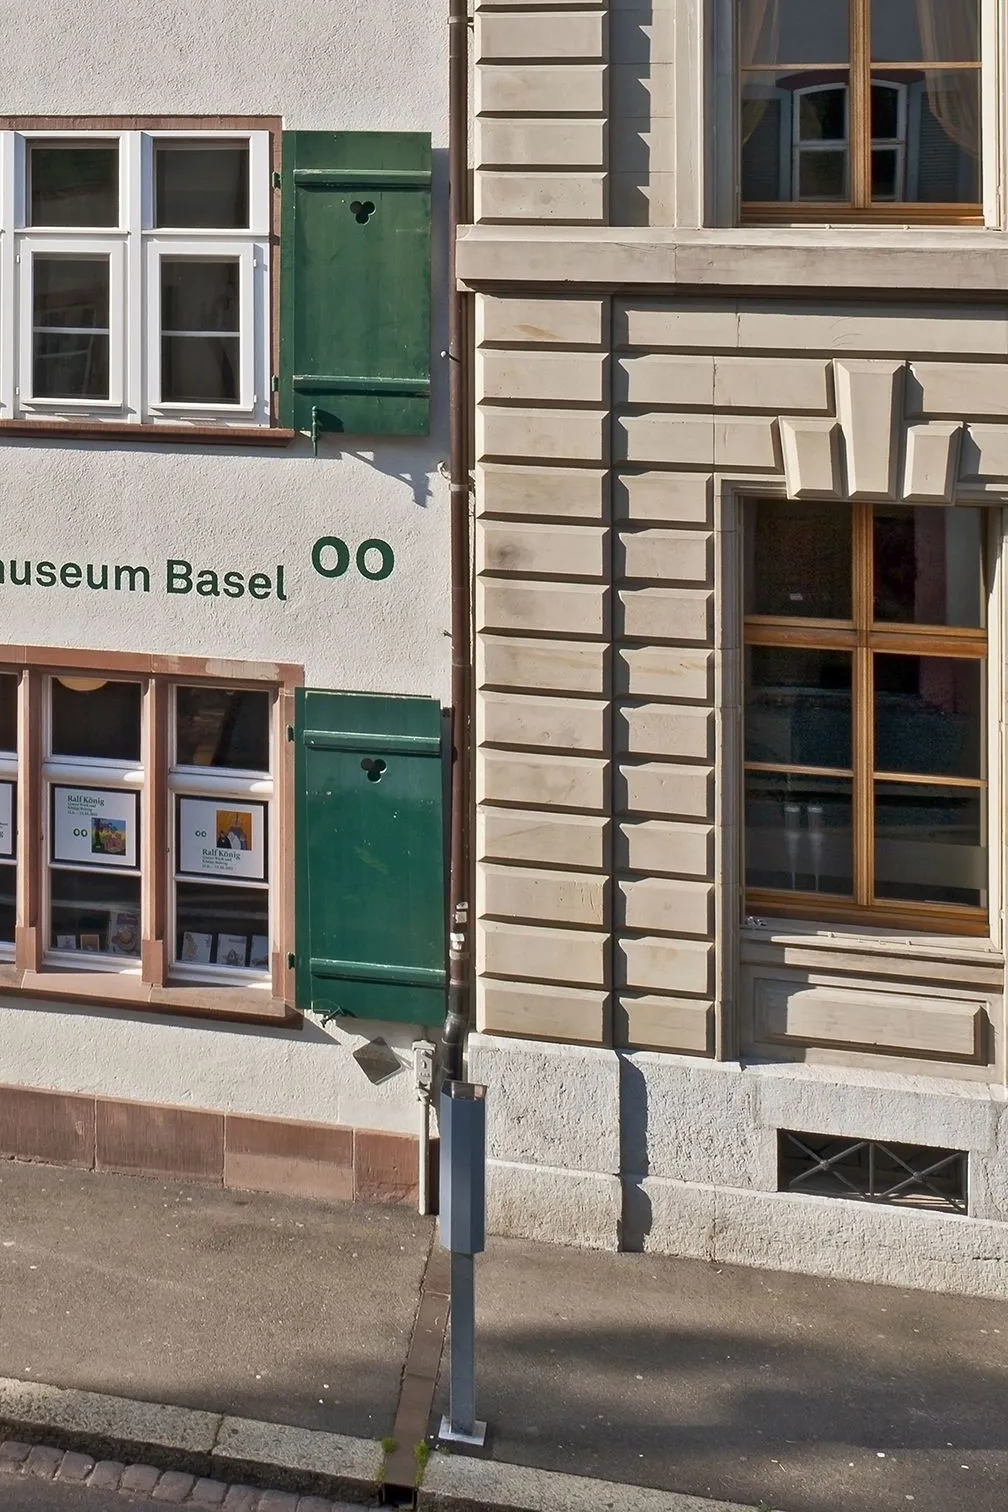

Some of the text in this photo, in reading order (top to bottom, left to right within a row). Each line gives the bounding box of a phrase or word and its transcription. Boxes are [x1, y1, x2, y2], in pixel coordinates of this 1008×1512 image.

[166, 559, 286, 602] Basel
[67, 794, 83, 803] Ralf
[83, 796, 105, 807] König
[202, 848, 218, 857] Ralf
[219, 850, 241, 860] König
